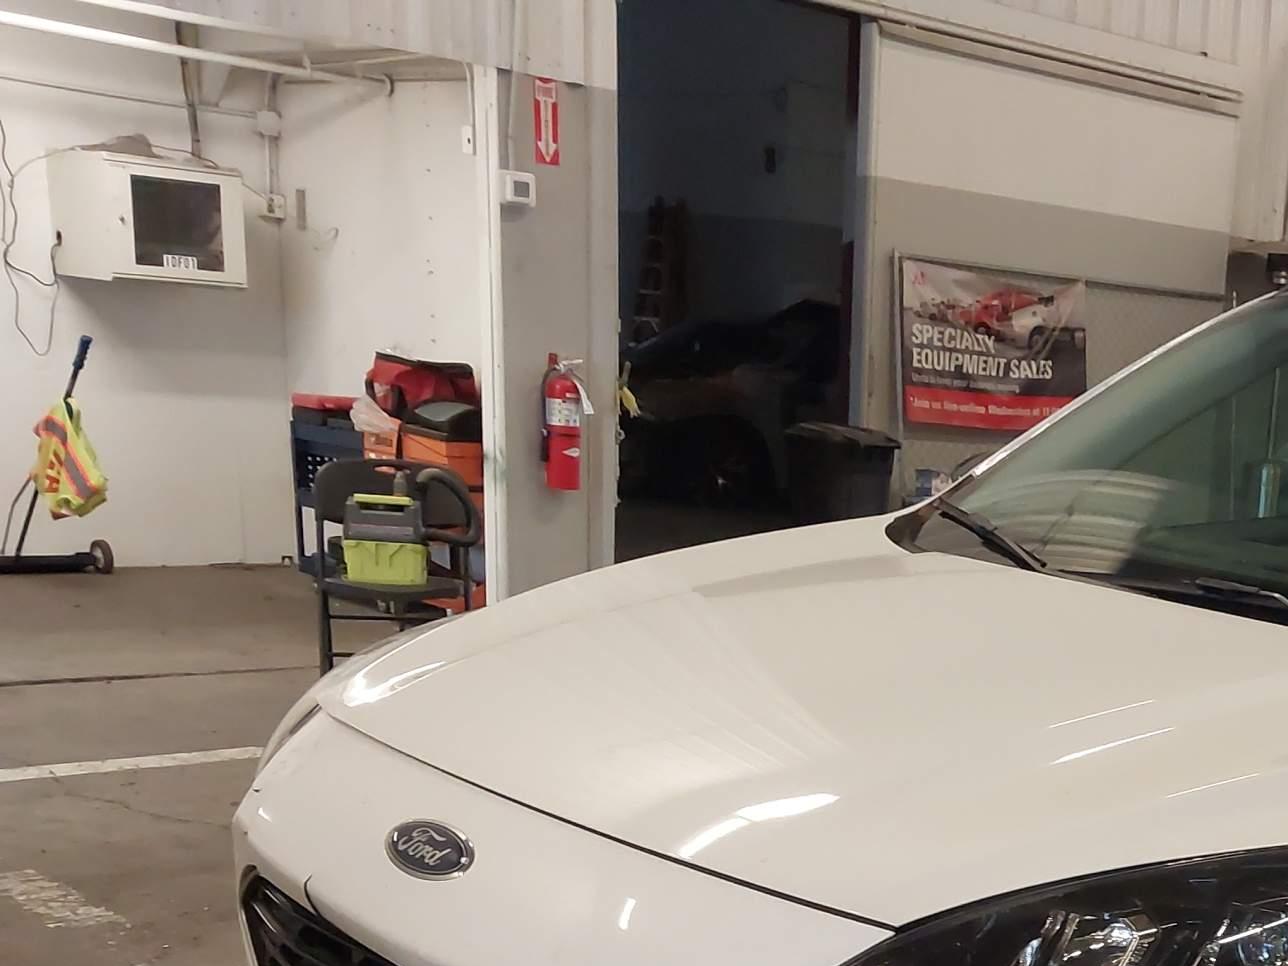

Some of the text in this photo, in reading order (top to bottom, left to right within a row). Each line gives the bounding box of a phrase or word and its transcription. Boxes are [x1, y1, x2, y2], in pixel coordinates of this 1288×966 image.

[912, 323, 995, 353] SPECIALTY
[912, 347, 1053, 379] EQUIPMENT SALES
[398, 827, 452, 866] Ford
